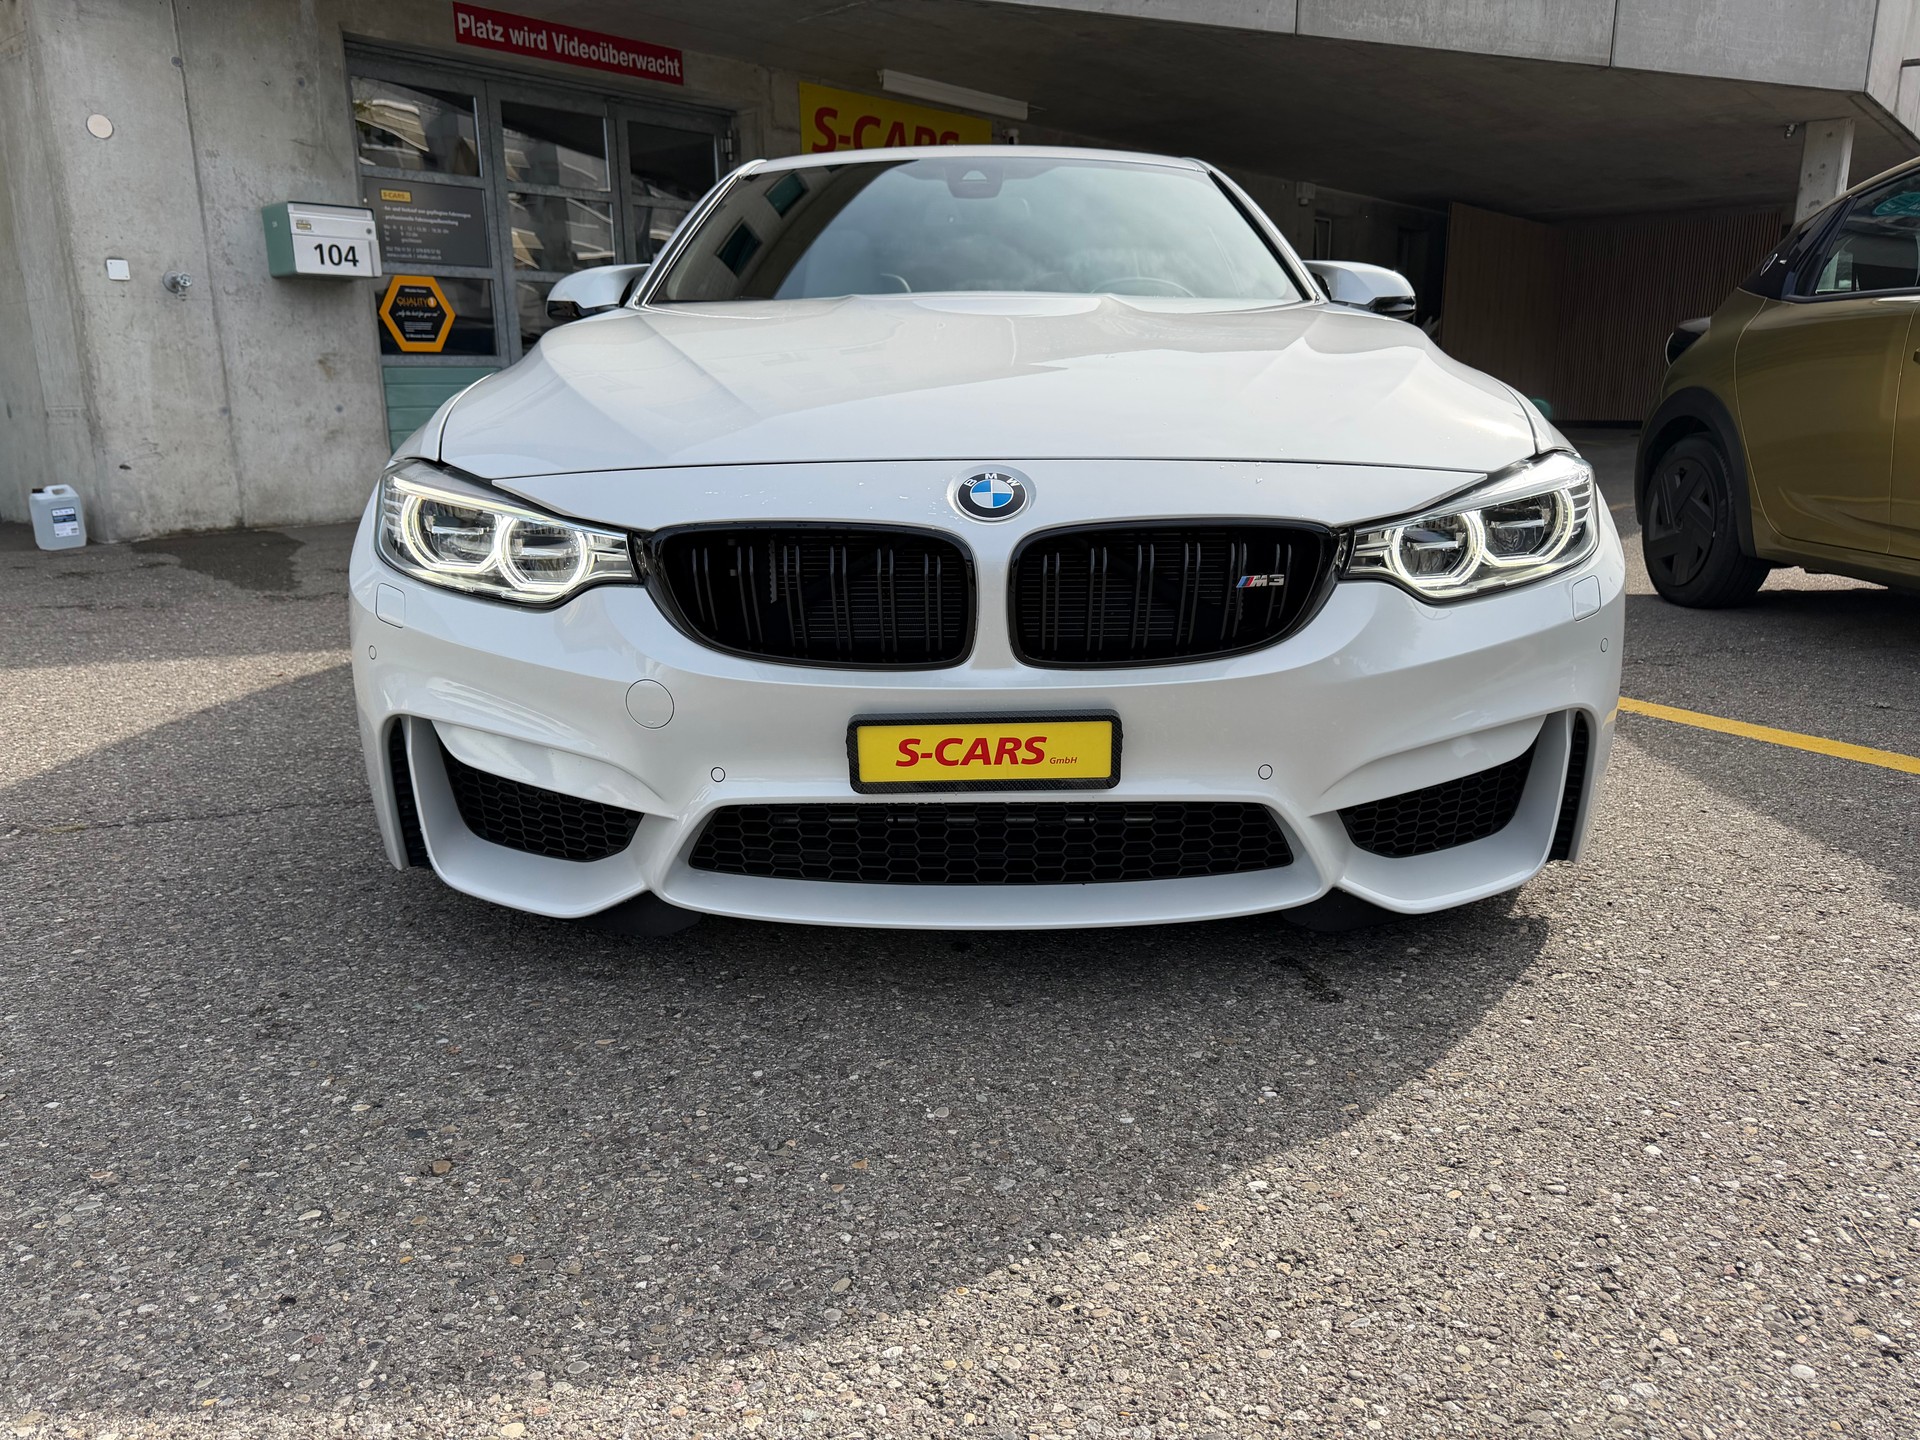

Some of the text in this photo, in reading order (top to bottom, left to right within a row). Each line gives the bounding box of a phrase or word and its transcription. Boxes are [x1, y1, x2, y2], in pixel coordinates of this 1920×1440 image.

[457, 12, 681, 77] Platz wird Videoüberwacht
[313, 243, 359, 267] 104
[963, 473, 1021, 488] BMW
[1249, 574, 1285, 588] M3
[895, 736, 1078, 768] S-CARS GmbH
